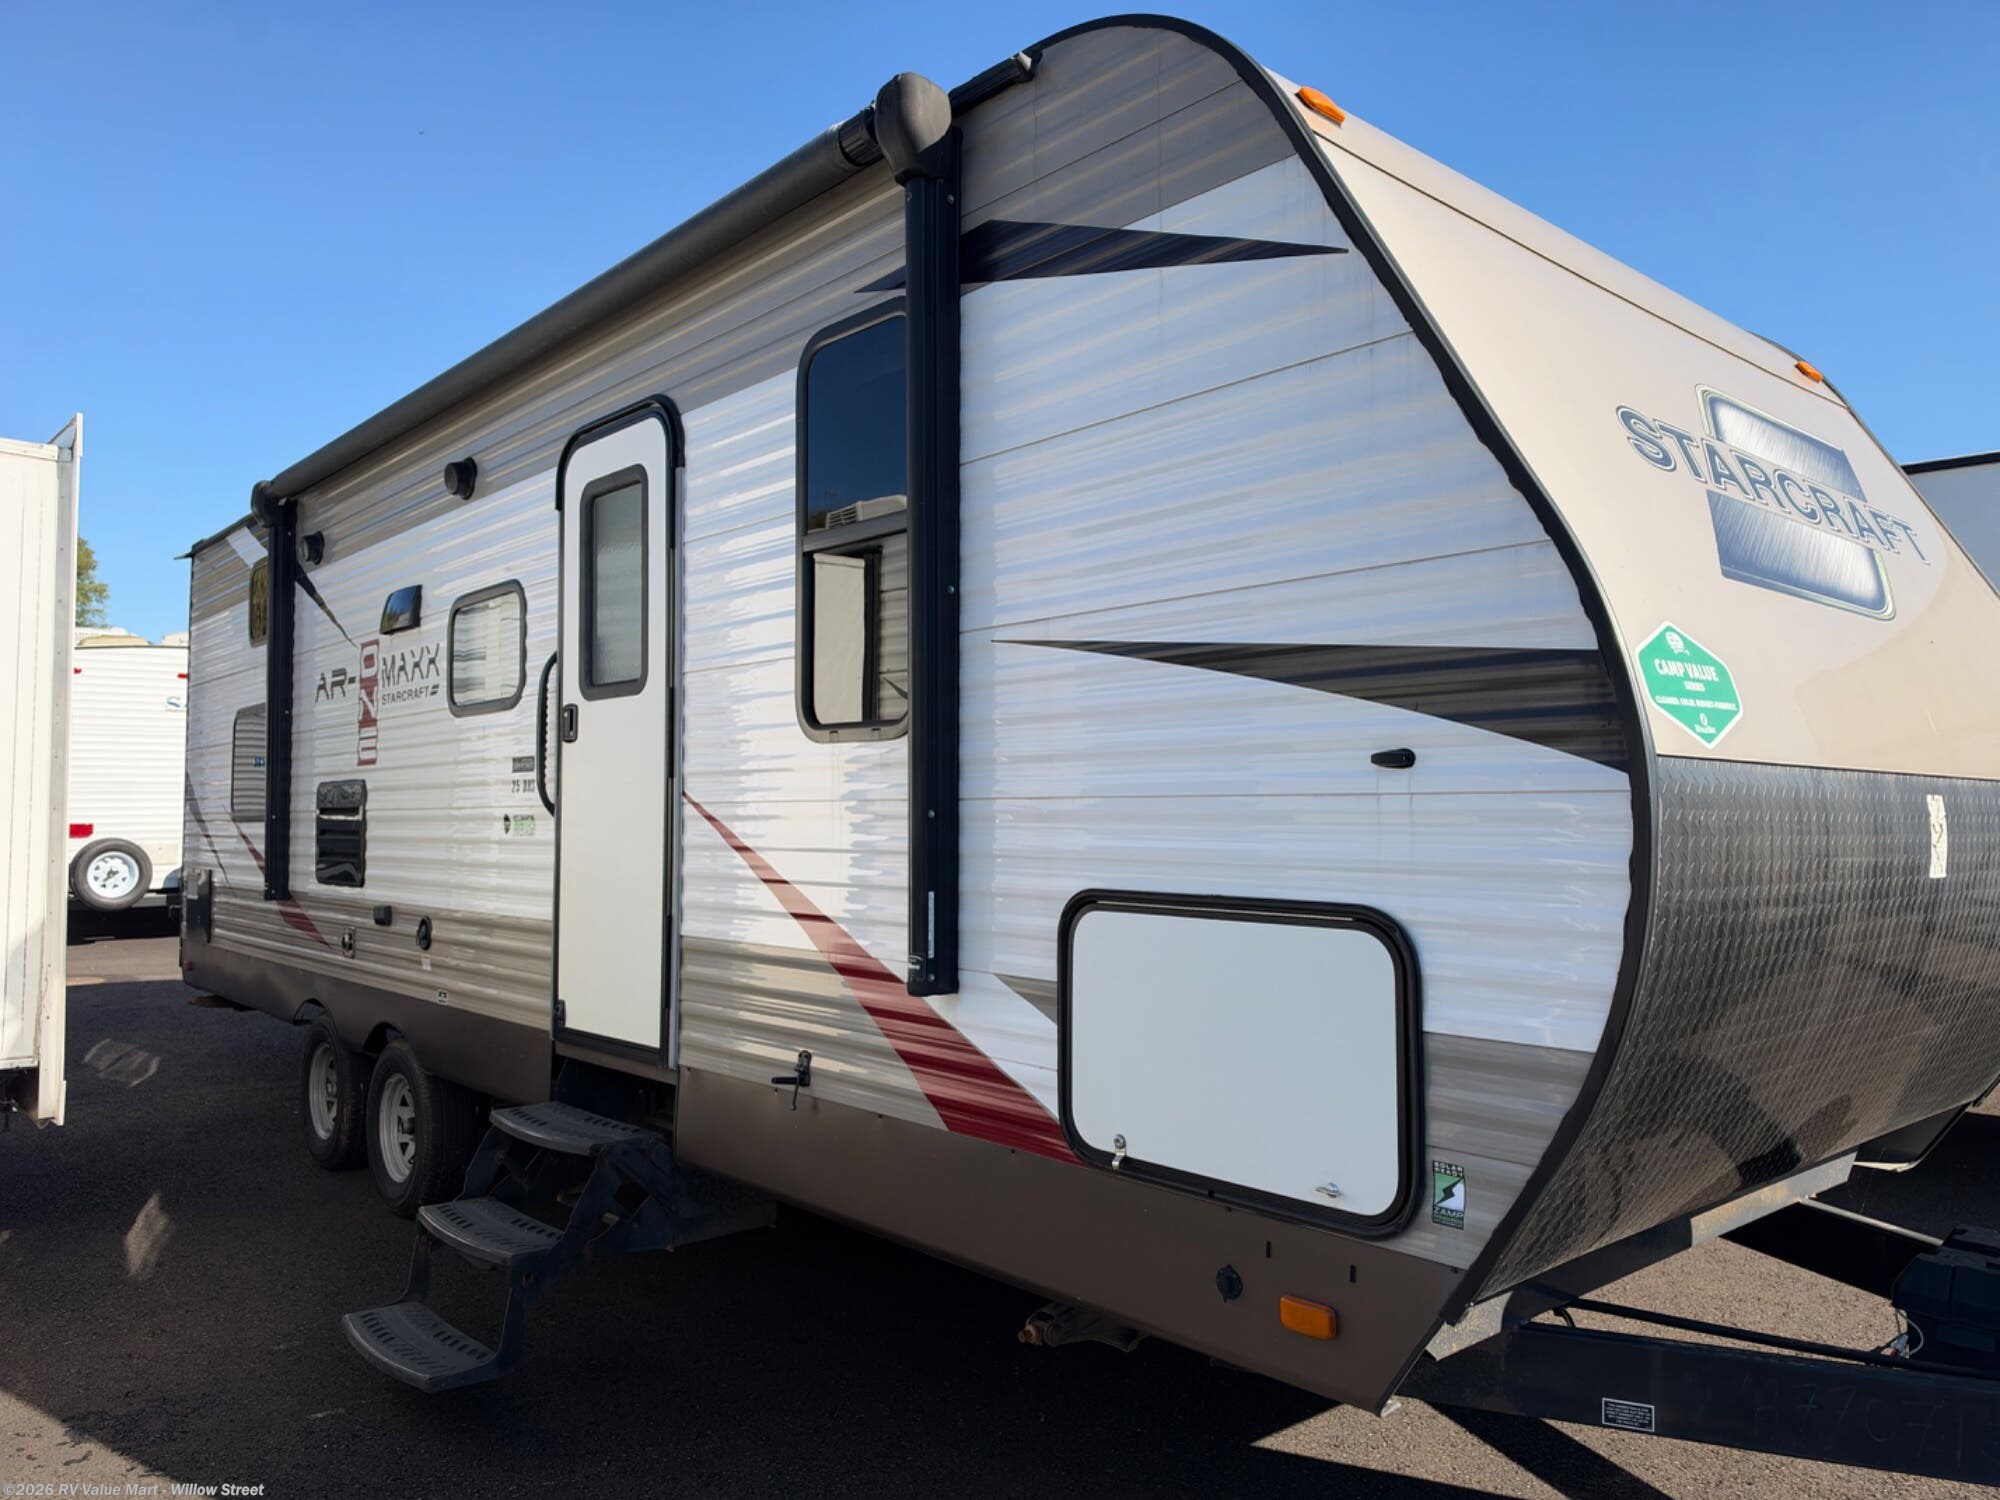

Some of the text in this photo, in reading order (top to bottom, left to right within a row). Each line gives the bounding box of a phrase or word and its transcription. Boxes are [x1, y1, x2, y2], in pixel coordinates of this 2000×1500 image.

[1615, 405, 1931, 566] STARCRAFT
[381, 643, 440, 688] MAXX
[1654, 658, 1719, 681] CAMP VALUE
[381, 685, 430, 705] STARCRAFT
[1433, 1161, 1463, 1172] SOLAR
